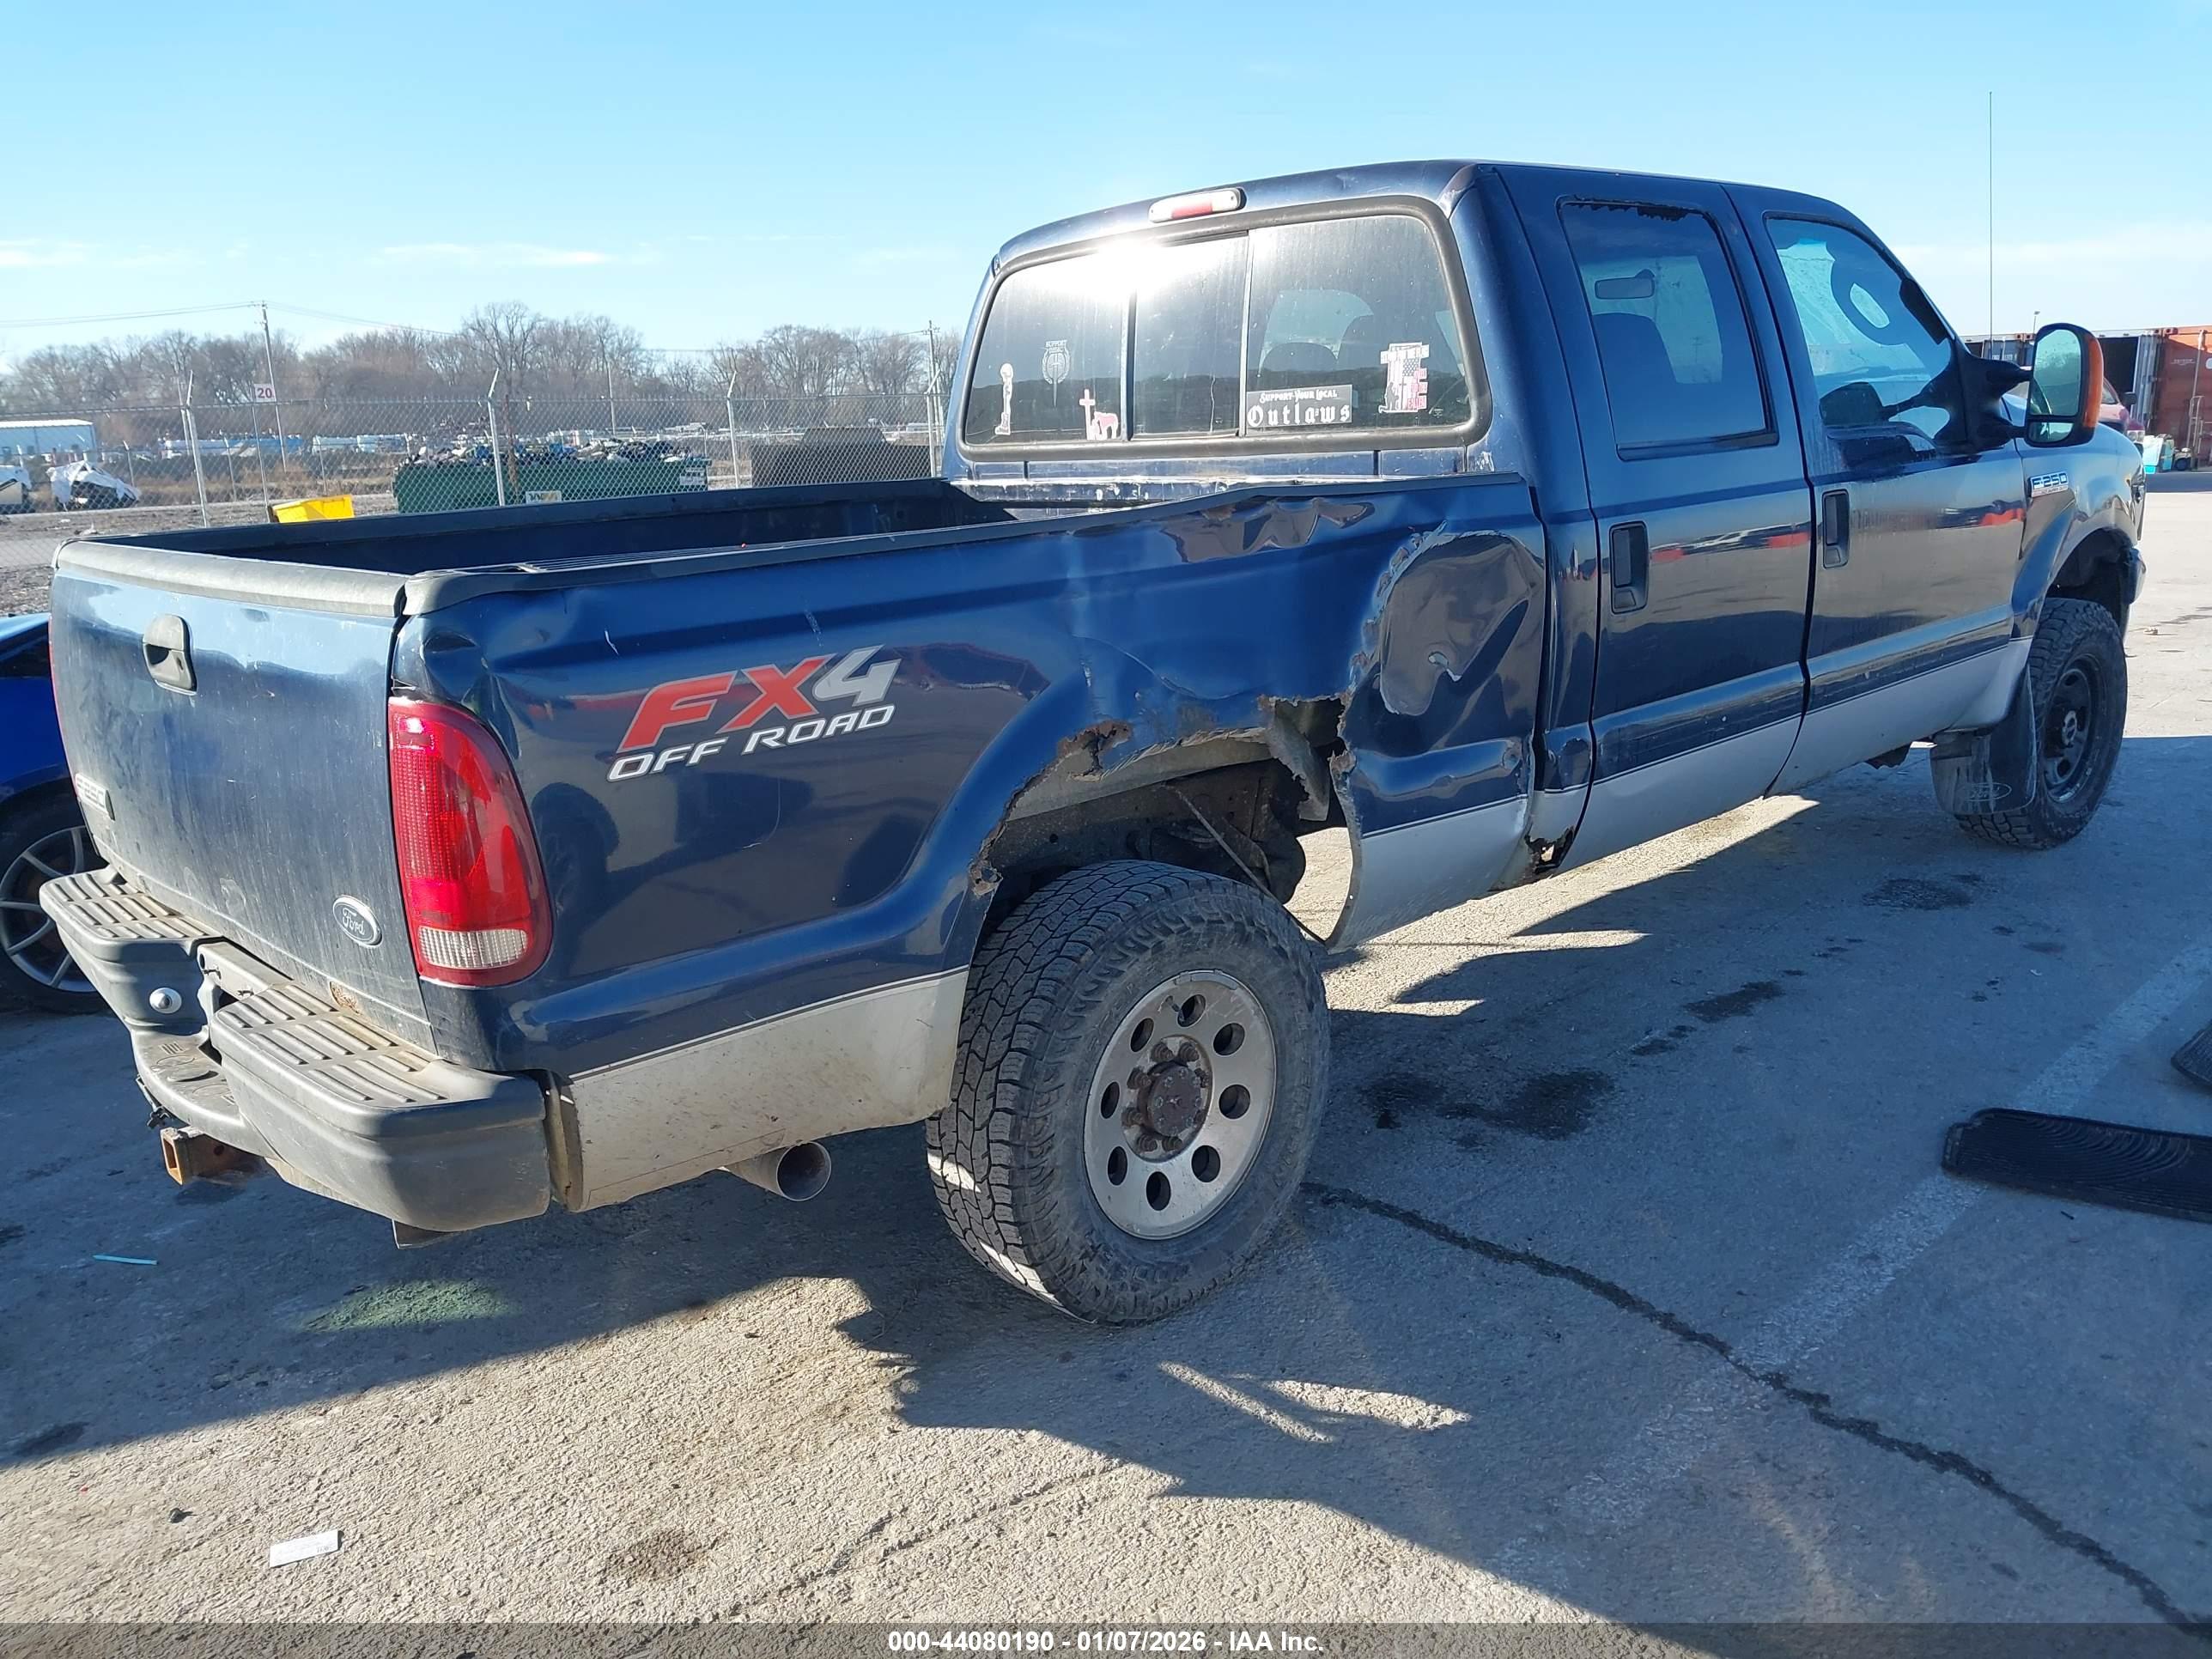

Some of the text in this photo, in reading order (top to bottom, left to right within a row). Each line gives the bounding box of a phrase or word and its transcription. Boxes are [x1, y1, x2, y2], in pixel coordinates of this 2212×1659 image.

[257, 387, 273, 398] 20
[1259, 389, 1338, 404] SUPPORT YOUR LOCAL
[1247, 402, 1350, 427] Outlaws
[616, 644, 902, 754] FX4
[606, 703, 896, 782] OFF ROAD
[342, 907, 366, 936] Ford
